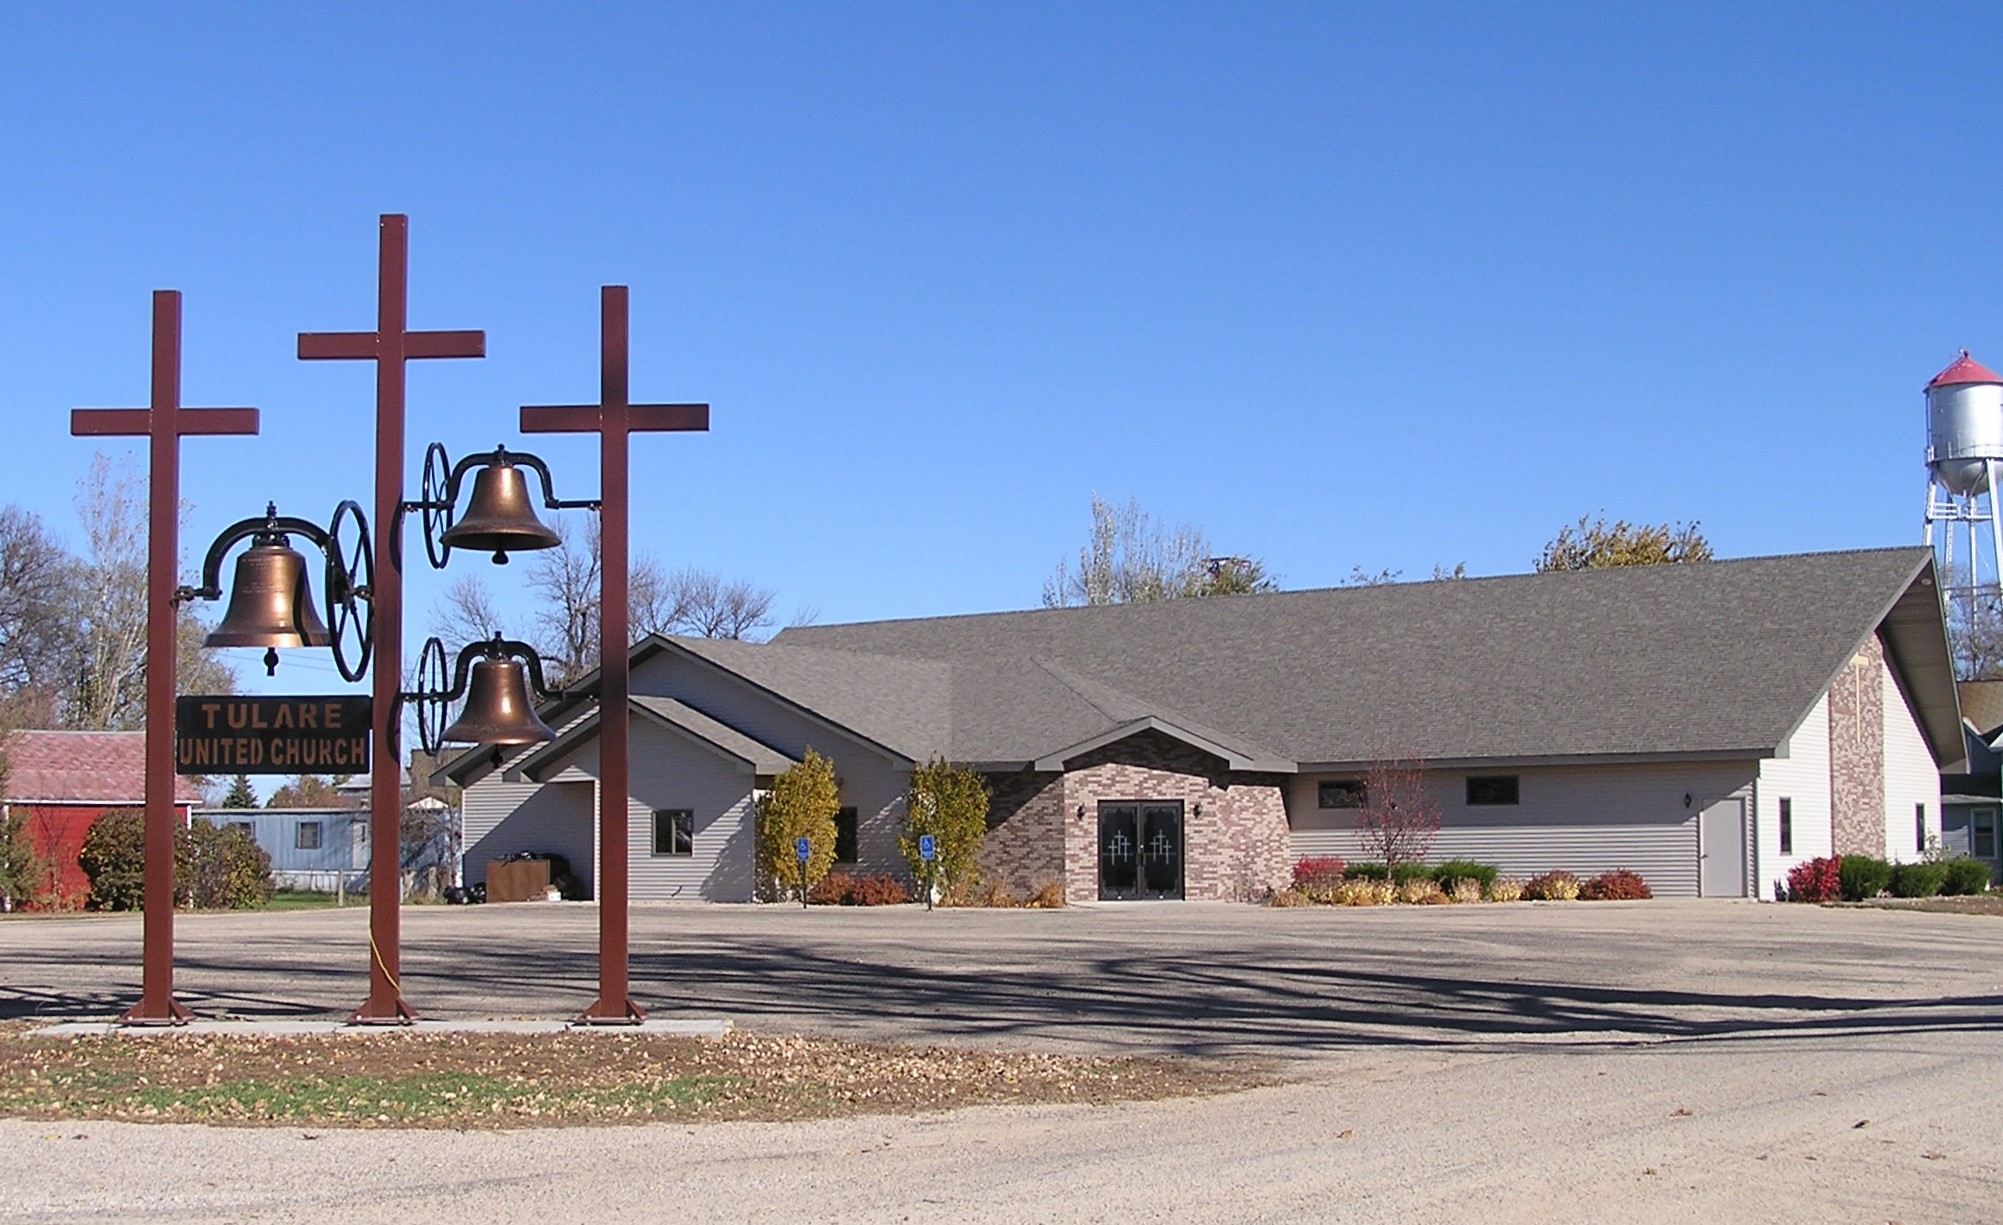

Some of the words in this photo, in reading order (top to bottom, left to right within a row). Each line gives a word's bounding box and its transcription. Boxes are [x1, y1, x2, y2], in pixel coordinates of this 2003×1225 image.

[202, 703, 342, 729] TULARE
[179, 737, 264, 765] UNITED
[270, 737, 365, 765] CHURCH
